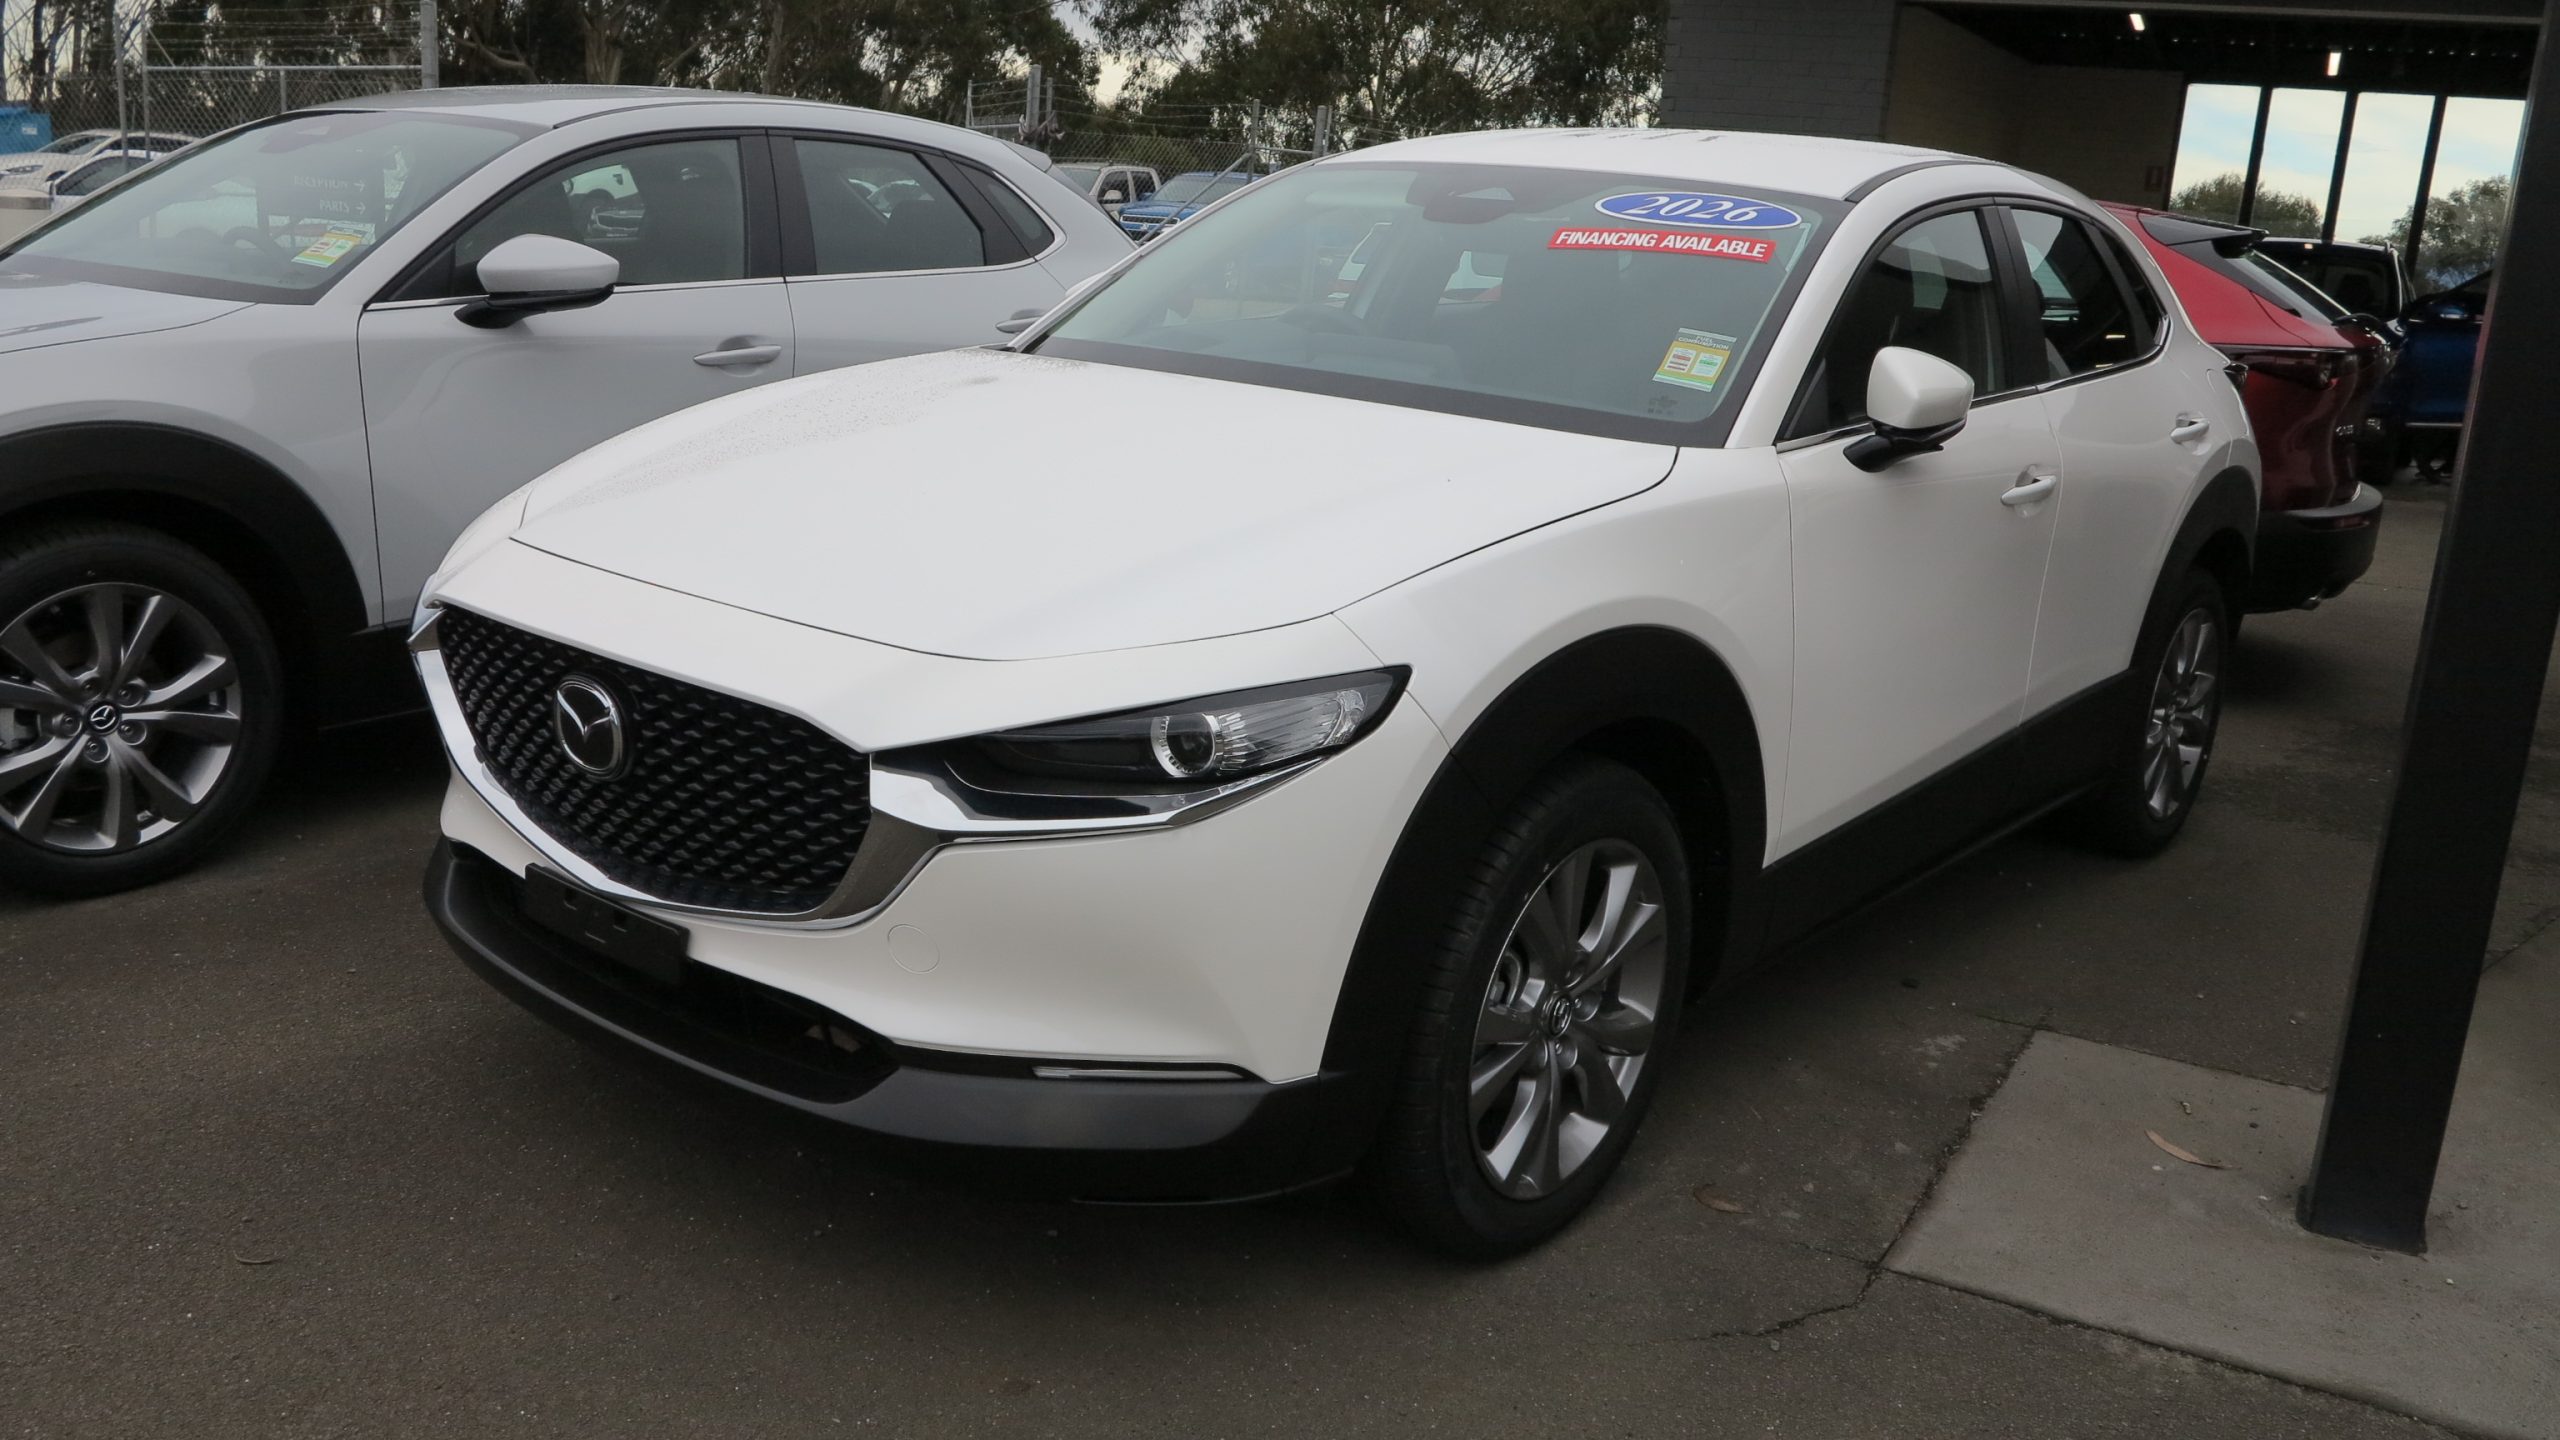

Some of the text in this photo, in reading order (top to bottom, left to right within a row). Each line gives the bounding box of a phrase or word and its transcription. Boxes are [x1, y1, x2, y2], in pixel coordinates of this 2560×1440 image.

[319, 199, 350, 213] PARTS
[1622, 196, 1772, 222] 2026
[1556, 231, 1768, 258] FINANCING AVAILABLE
